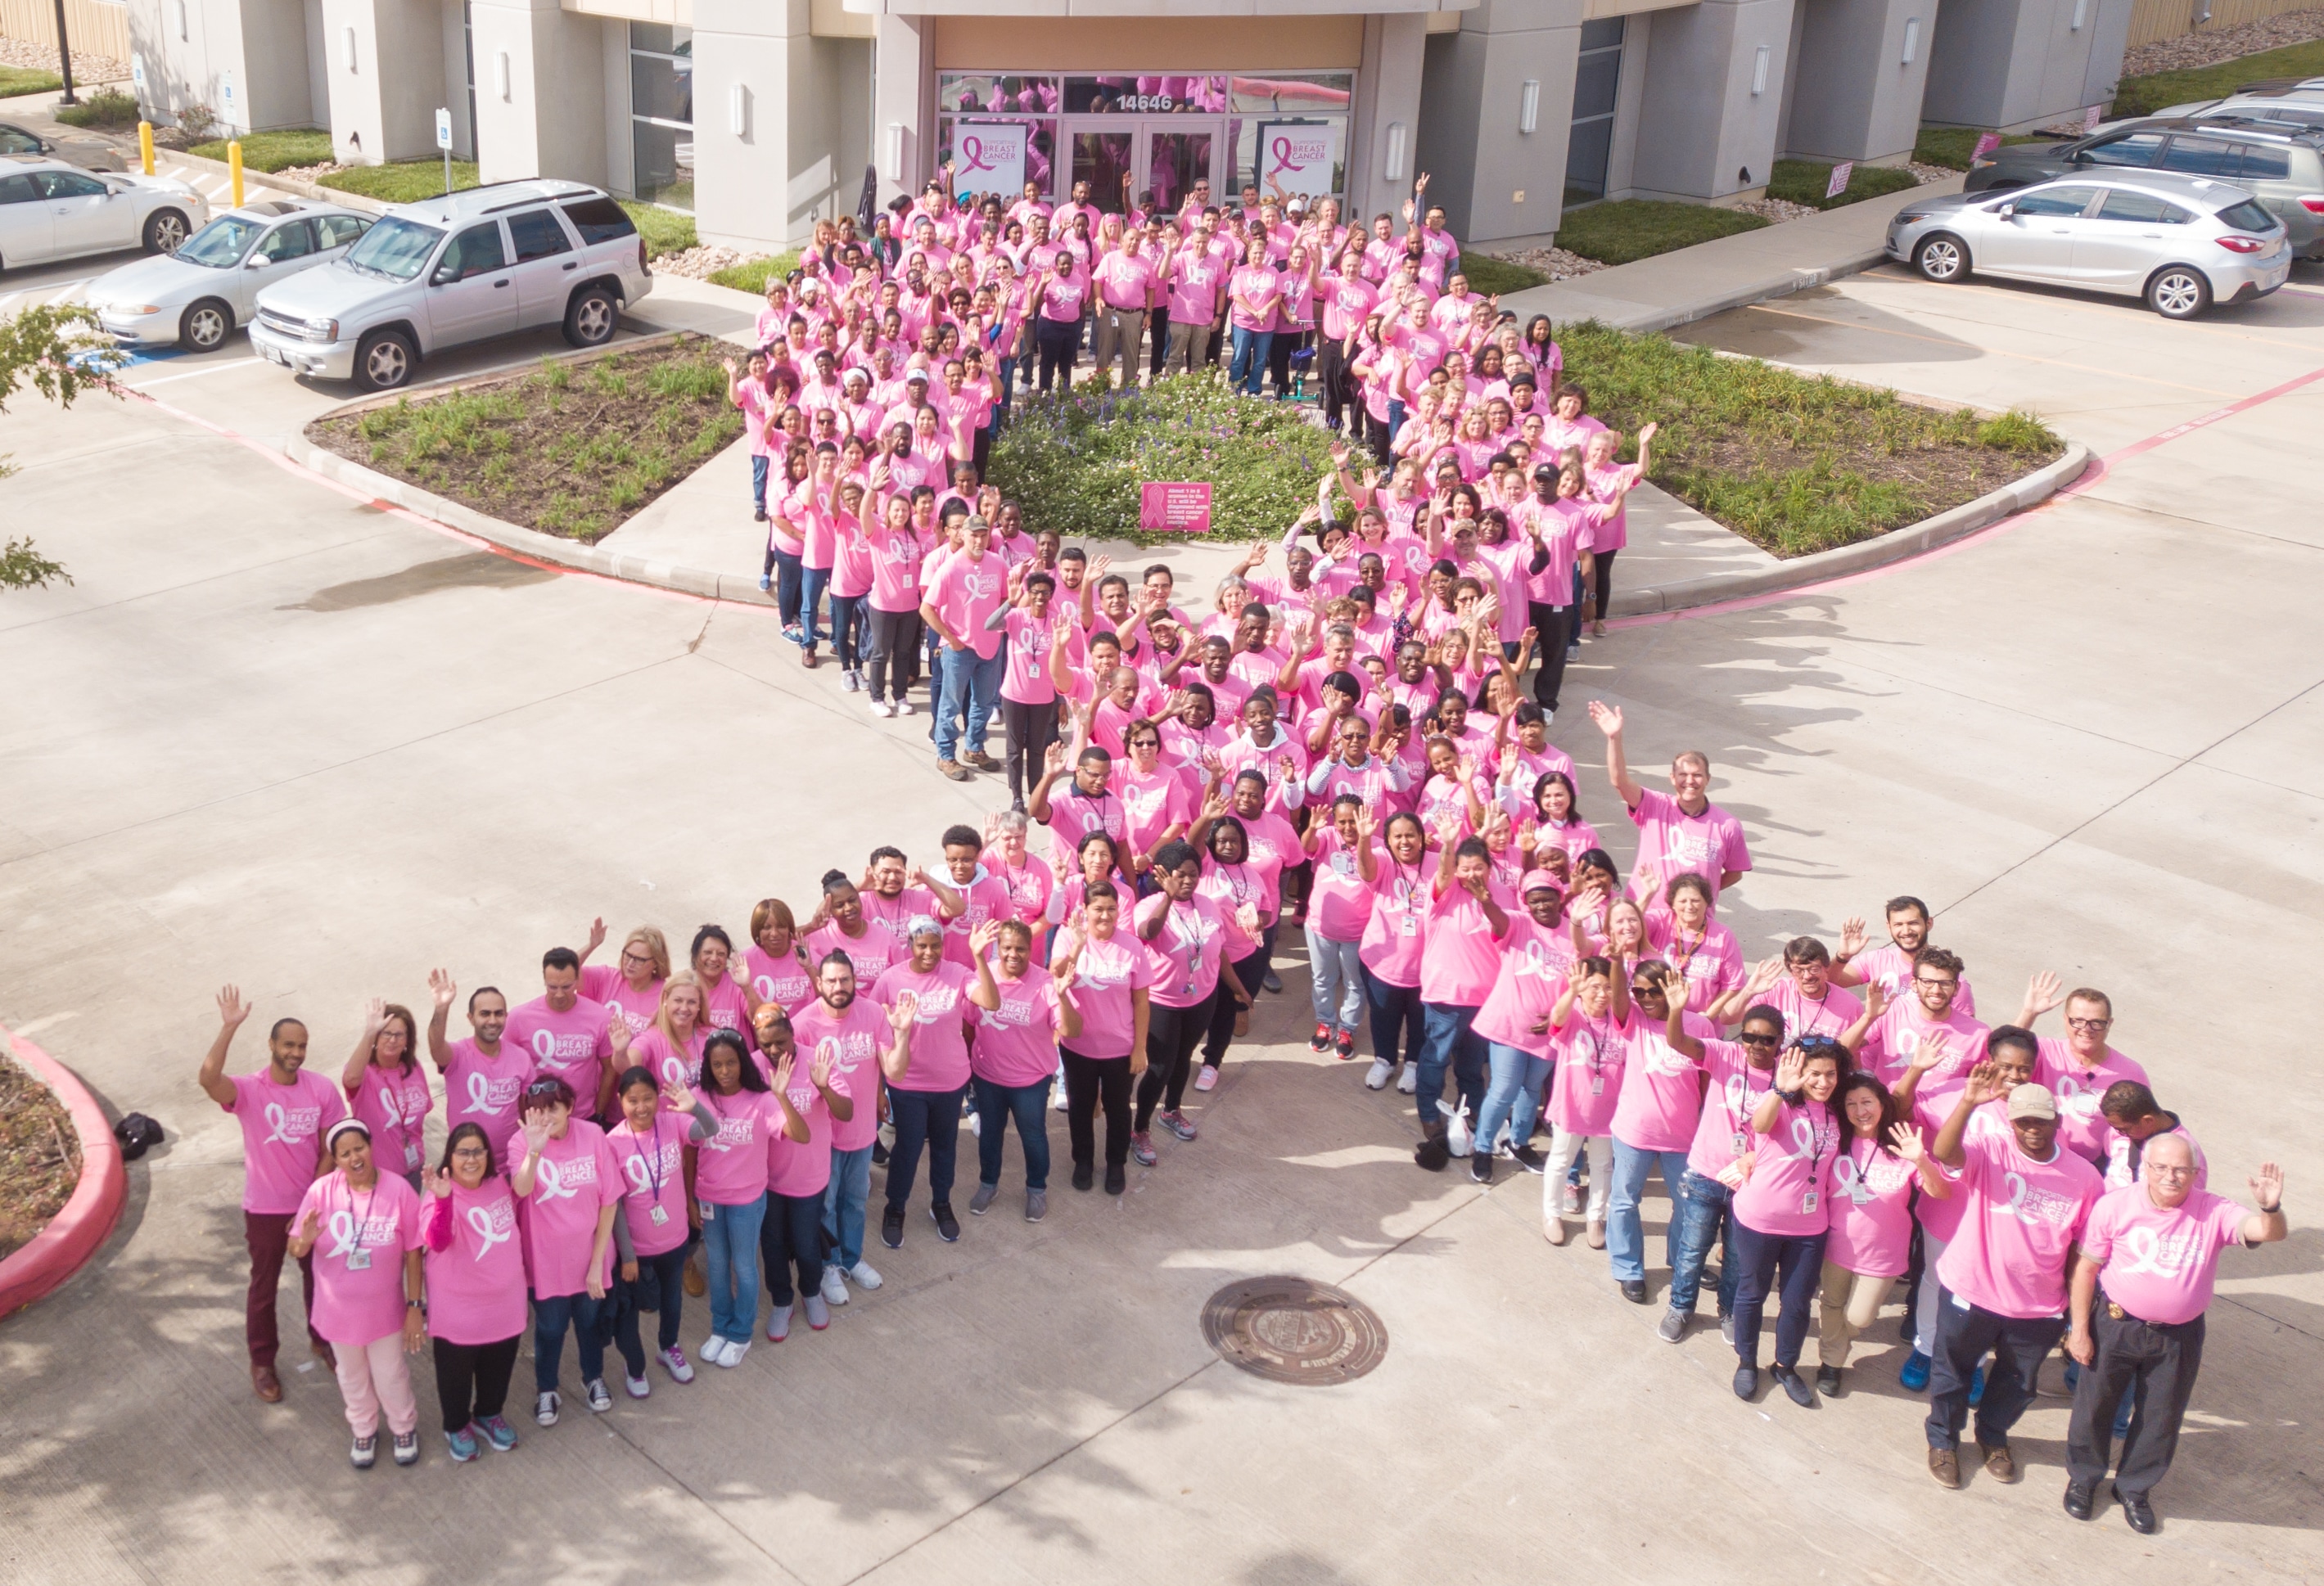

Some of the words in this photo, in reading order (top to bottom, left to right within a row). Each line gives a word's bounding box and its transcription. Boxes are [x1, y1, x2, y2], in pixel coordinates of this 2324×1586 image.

[1117, 95, 1172, 110] 14646
[1793, 273, 1817, 289] VSITOR
[854, 962, 887, 971] BREAST
[776, 981, 810, 991] BREAST
[776, 989, 810, 999] CANCER
[1000, 1003, 1032, 1015] BREAST
[710, 1015, 735, 1023] REAST
[996, 1009, 1031, 1023] CANCER
[556, 1040, 593, 1048] BREAST
[842, 1039, 875, 1051] BREAST
[555, 1048, 593, 1057] CANCER
[842, 1048, 877, 1061] CANCER
[1663, 1056, 1693, 1066] CANC
[718, 1124, 753, 1134] BREAST
[716, 1133, 753, 1142] CANCER
[559, 1161, 596, 1176] BREAST
[1866, 1167, 1906, 1181] REAST
[560, 1169, 597, 1183] CANCER
[1866, 1178, 1905, 1191] ANCER
[2028, 1184, 2074, 1205] SUPPORTING
[2027, 1191, 2072, 1211] BREAST
[2024, 1198, 2069, 1224] CANCER
